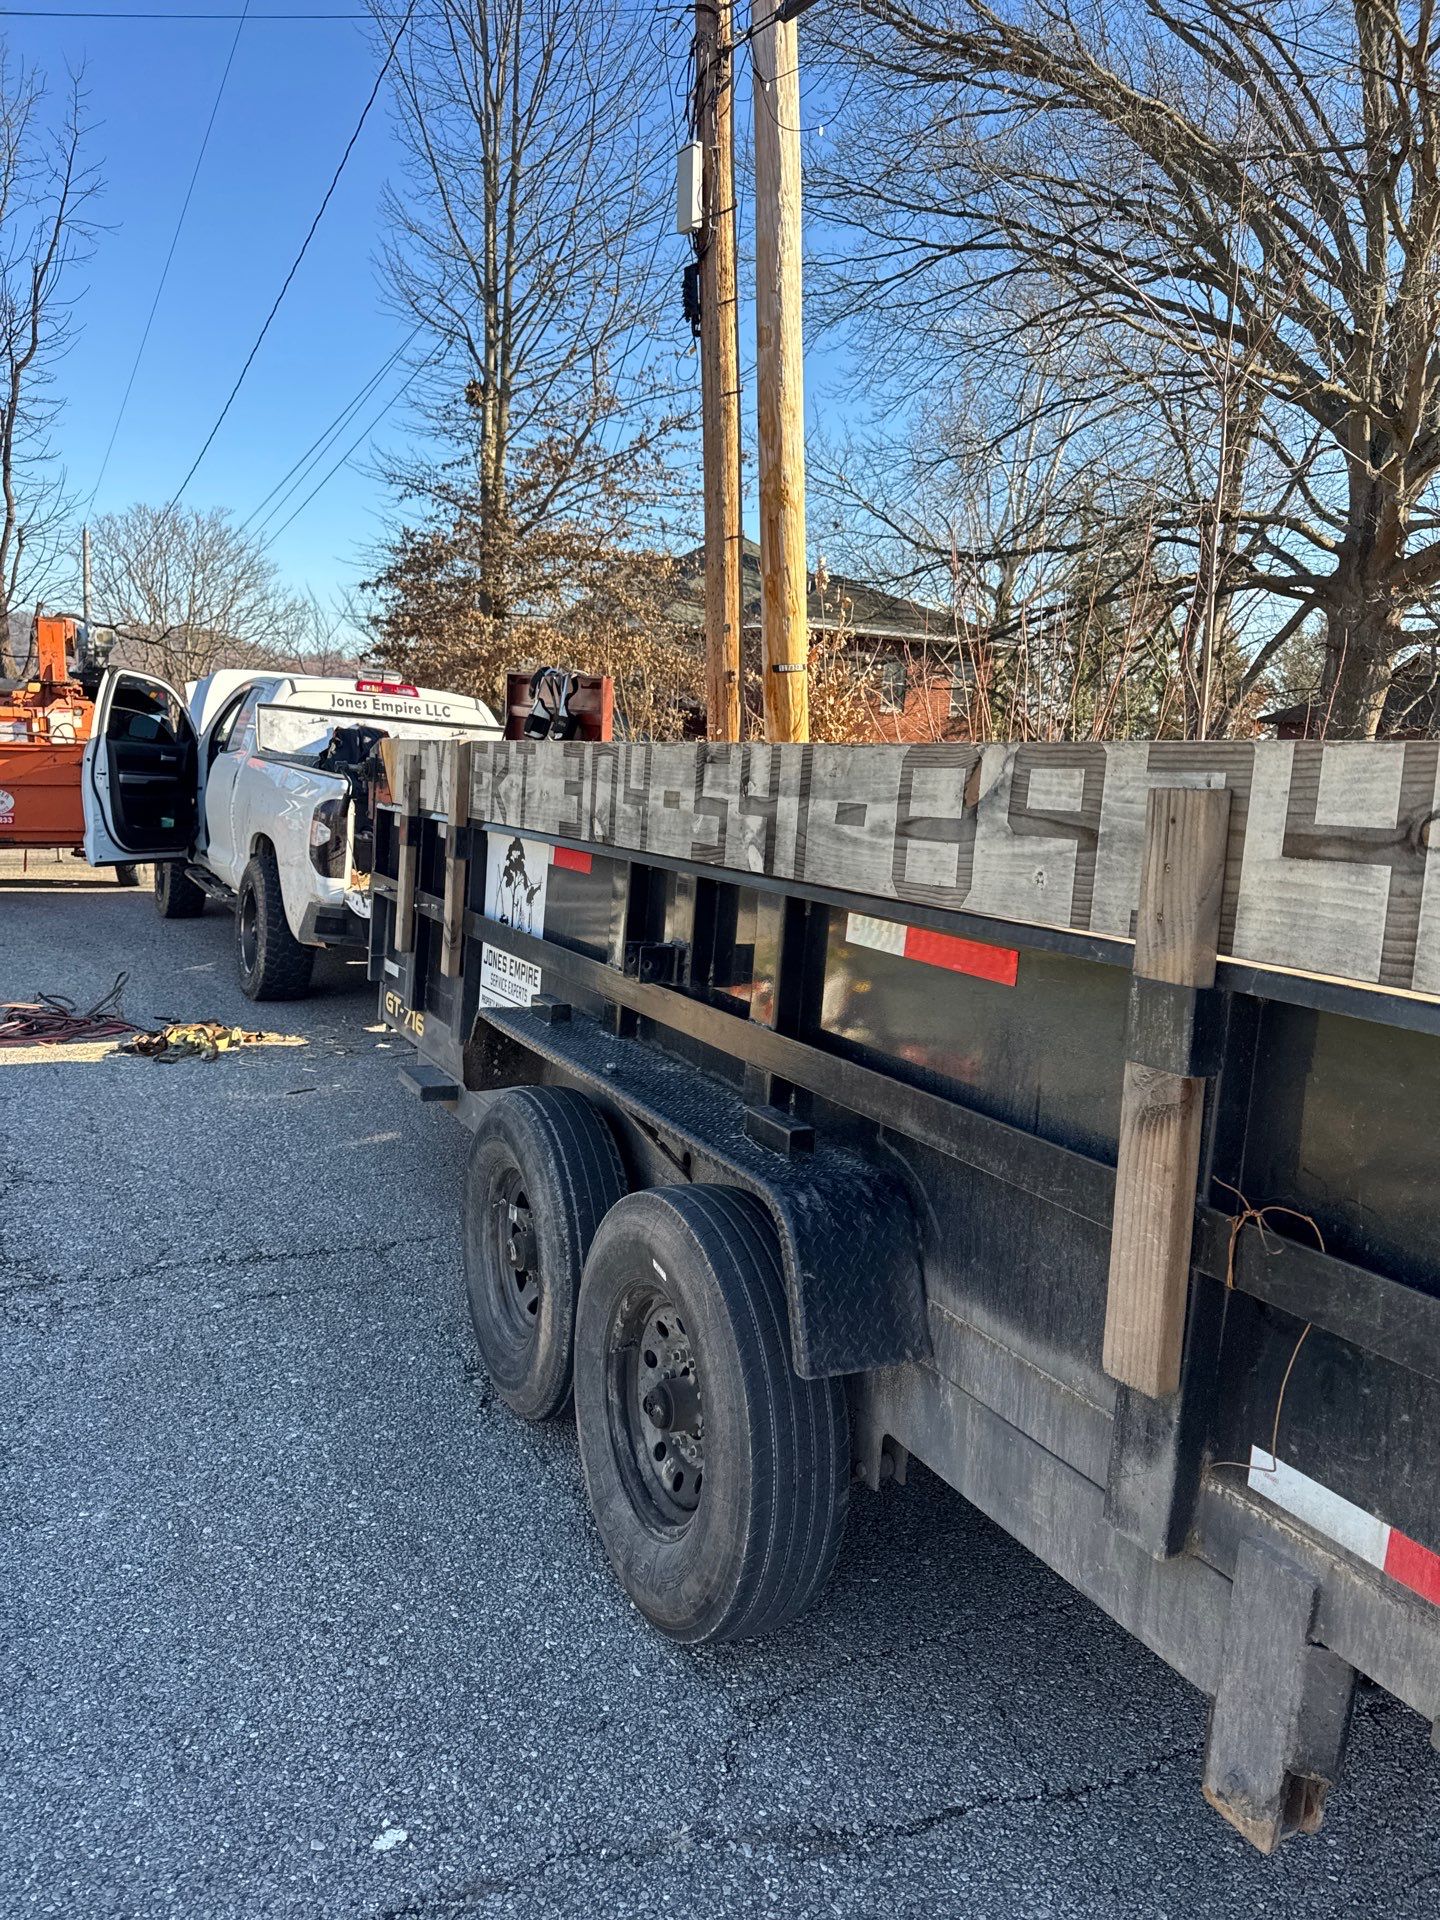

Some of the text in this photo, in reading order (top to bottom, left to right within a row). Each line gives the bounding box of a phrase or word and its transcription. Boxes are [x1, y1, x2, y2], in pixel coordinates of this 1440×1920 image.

[331, 694, 451, 718] Jones Empire LLC
[484, 948, 539, 988] JONES EMPIRE
[490, 972, 528, 1003] SERVICE EXPERTS
[385, 991, 424, 1037] GT-716
